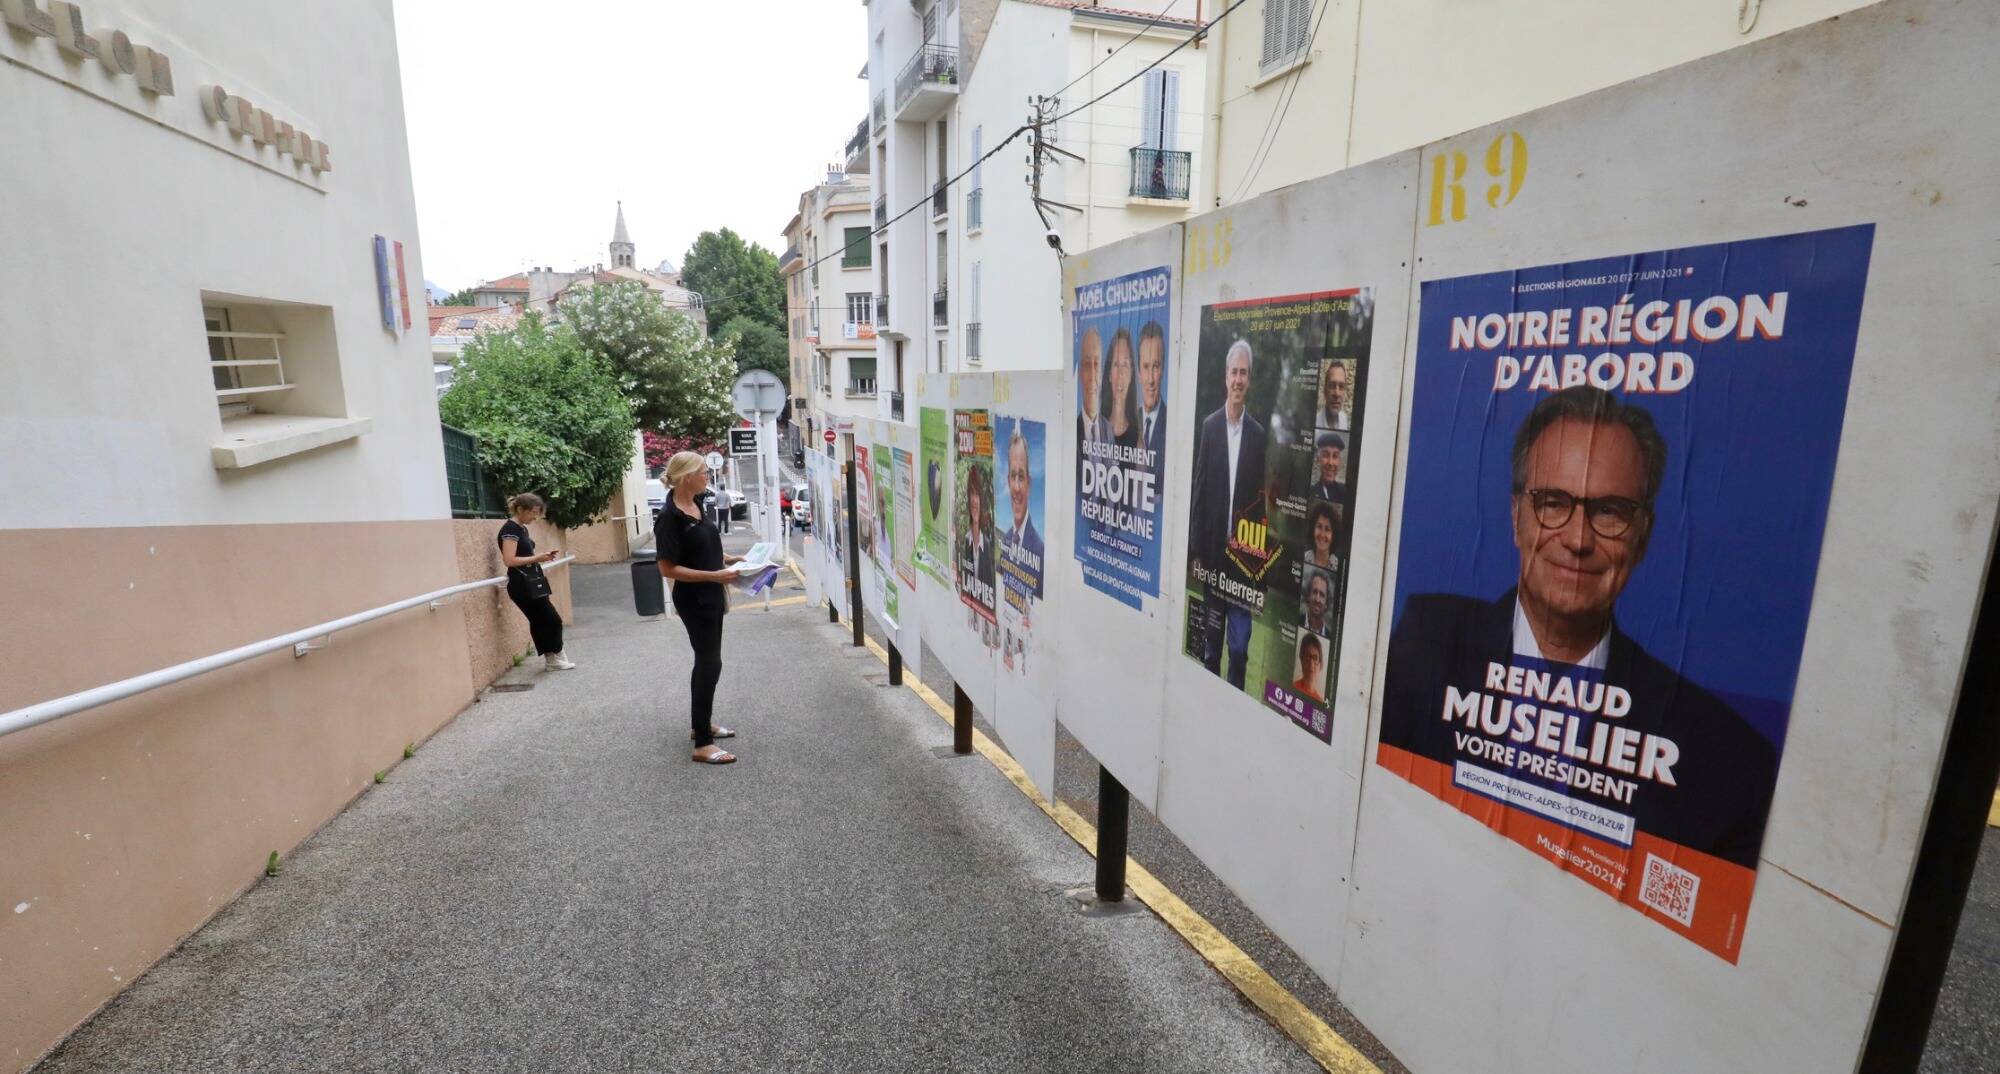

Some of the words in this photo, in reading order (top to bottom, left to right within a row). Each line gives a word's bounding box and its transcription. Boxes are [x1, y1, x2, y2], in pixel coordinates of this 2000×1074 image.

[1425, 151, 1468, 227] R
[1484, 131, 1528, 209] 9
[1106, 273, 1168, 306] CHUISANO
[1518, 281, 1556, 293] ÉLECTIONS
[1608, 275, 1618, 284] 20
[1639, 270, 1660, 281] JUIN
[1660, 268, 1682, 279] 2021
[1285, 318, 1300, 329] 2021
[1449, 308, 1573, 350] NOTRE
[1578, 291, 1789, 347] RÉGION
[1493, 351, 1695, 393] D'ABORD
[959, 431, 974, 453] ZOU
[1082, 440, 1156, 468] RASSEMBLEMENT
[1082, 460, 1155, 513] DROITE
[1081, 497, 1153, 541] RÉPUBLICAINE
[1011, 543, 1040, 572] MARIANI
[1090, 529, 1110, 545] DEBOUT
[1110, 538, 1116, 548] LA
[1117, 540, 1139, 557] FRANCE
[1192, 557, 1217, 586] Hervé
[1219, 572, 1264, 608] Guerrera
[1485, 662, 1633, 718] RENAUD
[1441, 685, 1680, 787] MUSELIER
[1455, 731, 1515, 767] VOTRE
[1517, 750, 1638, 804] PRÉSIDENT
[1462, 770, 1491, 786] RÉGION
[1536, 833, 1626, 891] Muselier2021.fr
